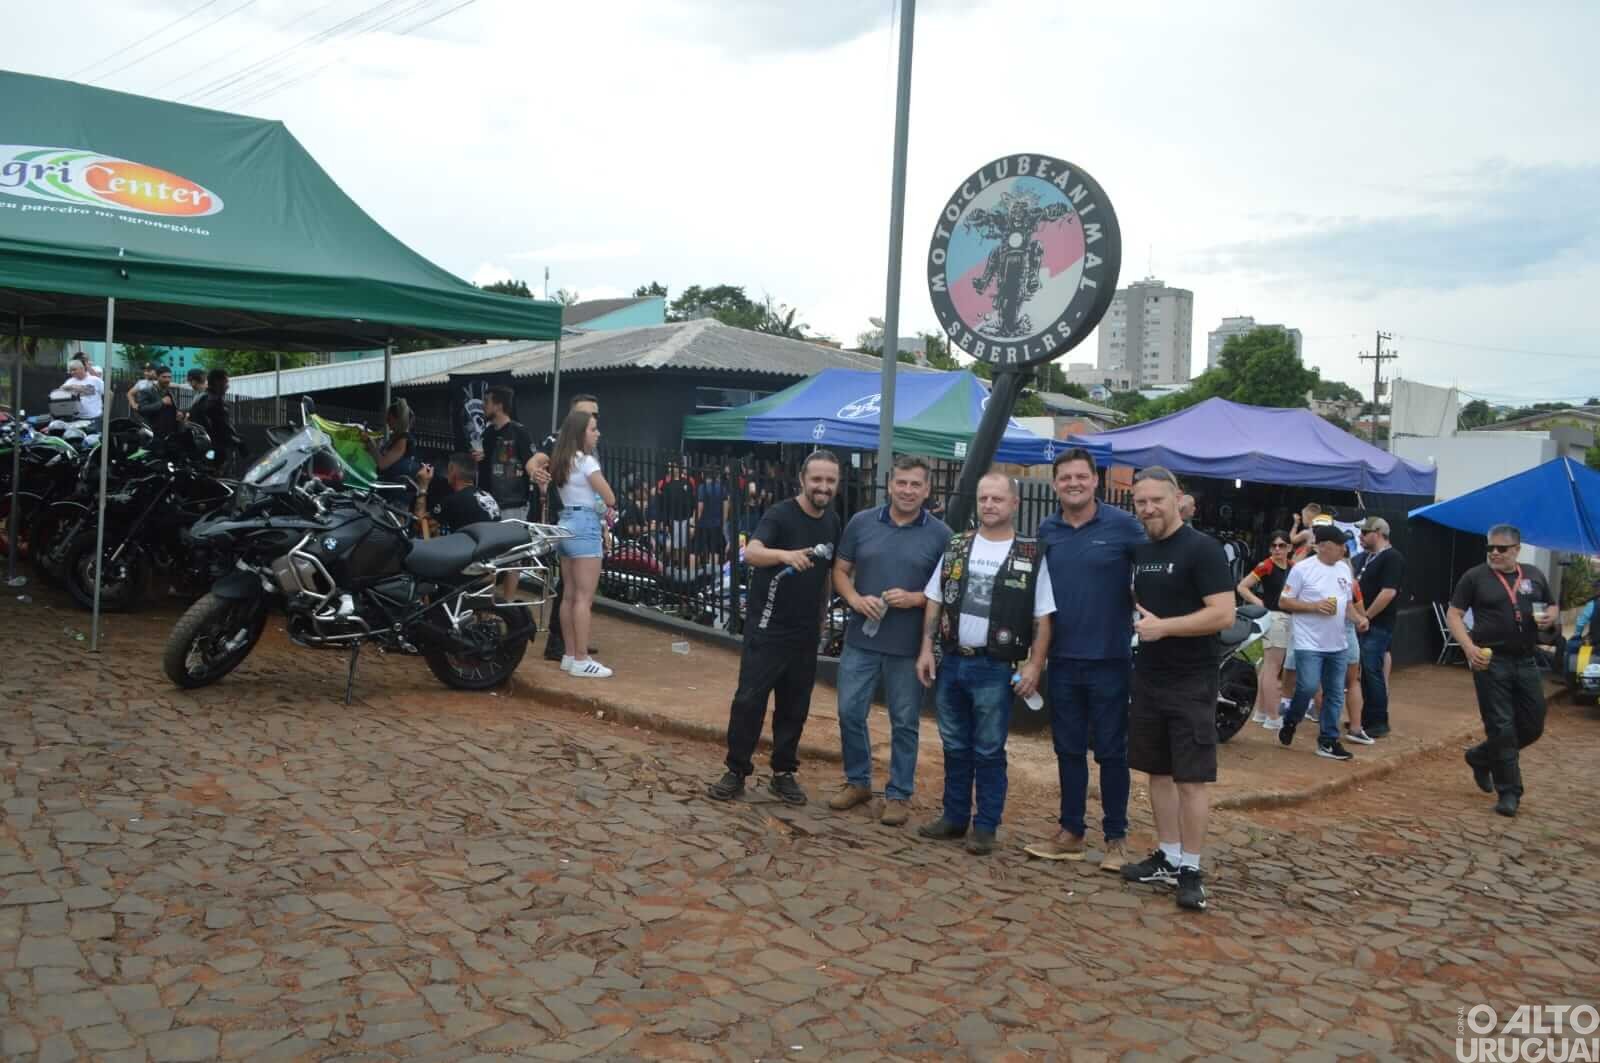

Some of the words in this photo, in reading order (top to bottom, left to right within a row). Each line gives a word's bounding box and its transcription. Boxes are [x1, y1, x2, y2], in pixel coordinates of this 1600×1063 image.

[0, 160, 73, 187] gri
[83, 164, 209, 206] Center
[21, 203, 90, 214] parceiro
[95, 209, 115, 217] no
[119, 214, 210, 236] agronegócio
